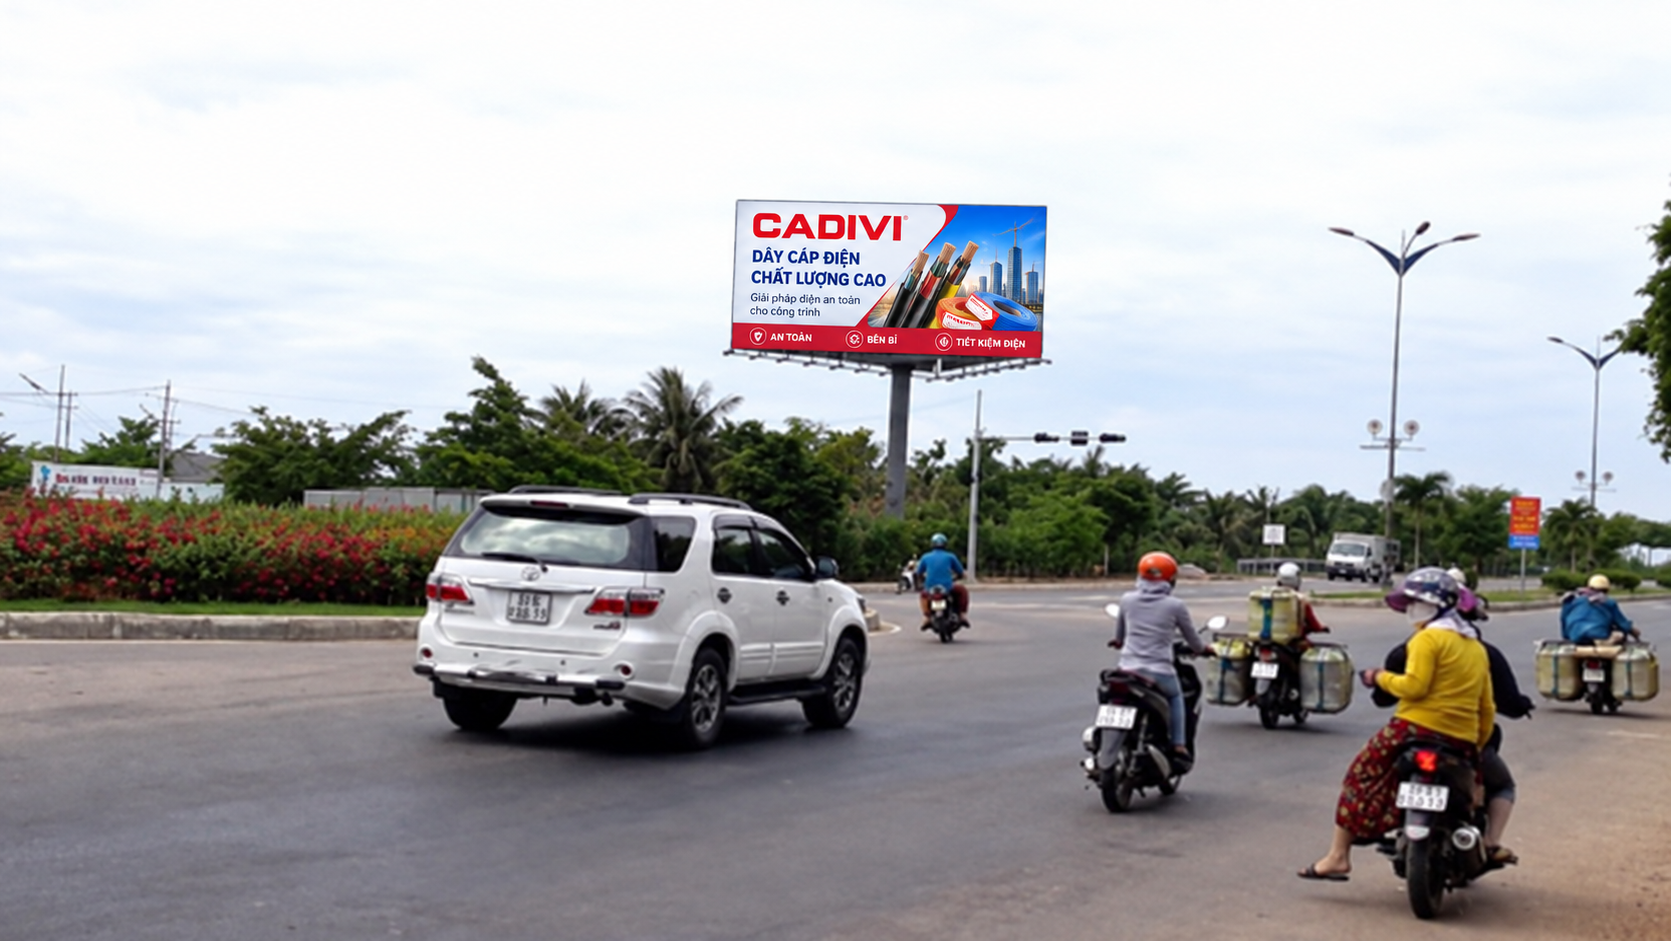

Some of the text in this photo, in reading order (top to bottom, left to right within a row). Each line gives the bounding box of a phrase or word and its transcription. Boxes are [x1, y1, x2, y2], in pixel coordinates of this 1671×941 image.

[752, 213, 902, 241] CADIVI
[752, 246, 860, 268] DÂY CÁP ĐIỆN
[796, 270, 850, 289] LƯỢNG
[853, 273, 887, 287] CAO
[823, 296, 836, 304] an
[750, 305, 768, 315] cho
[770, 333, 784, 341] AN
[1003, 338, 1026, 350] ĐIỆN
